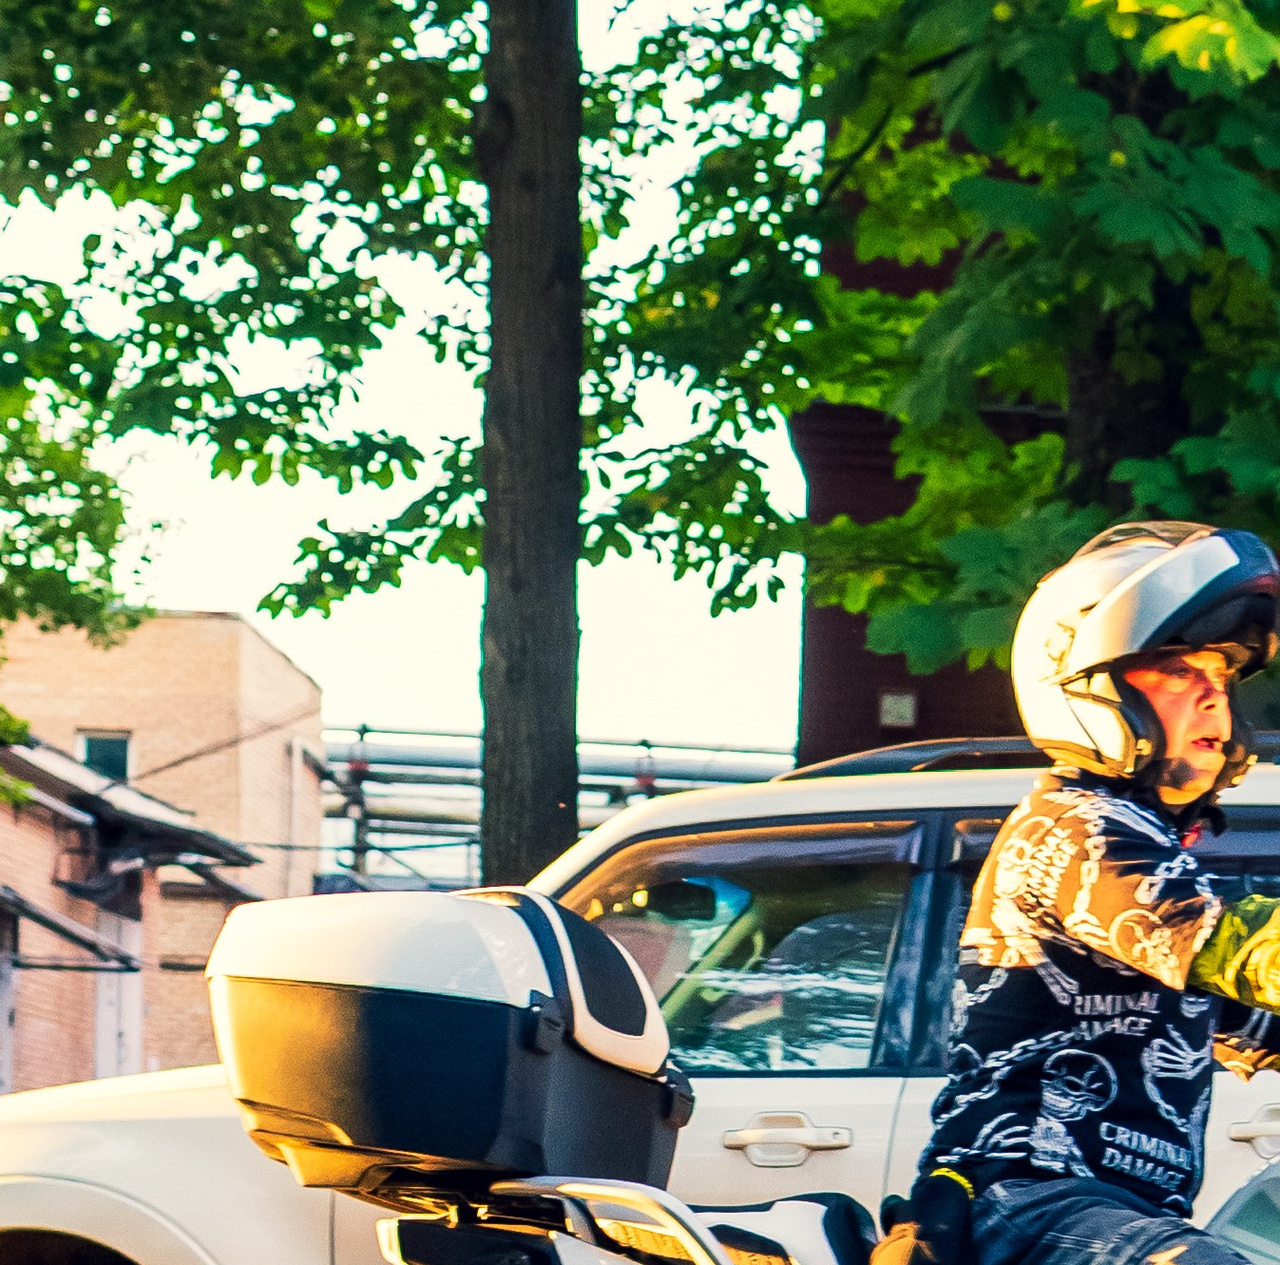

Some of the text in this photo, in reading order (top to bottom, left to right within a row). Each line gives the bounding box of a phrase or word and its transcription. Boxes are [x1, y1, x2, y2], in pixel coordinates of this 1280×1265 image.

[1036, 838, 1080, 909] AMAGE
[1099, 1121, 1193, 1171] CRIMINAL
[1101, 1147, 1187, 1192] DAMAGE
